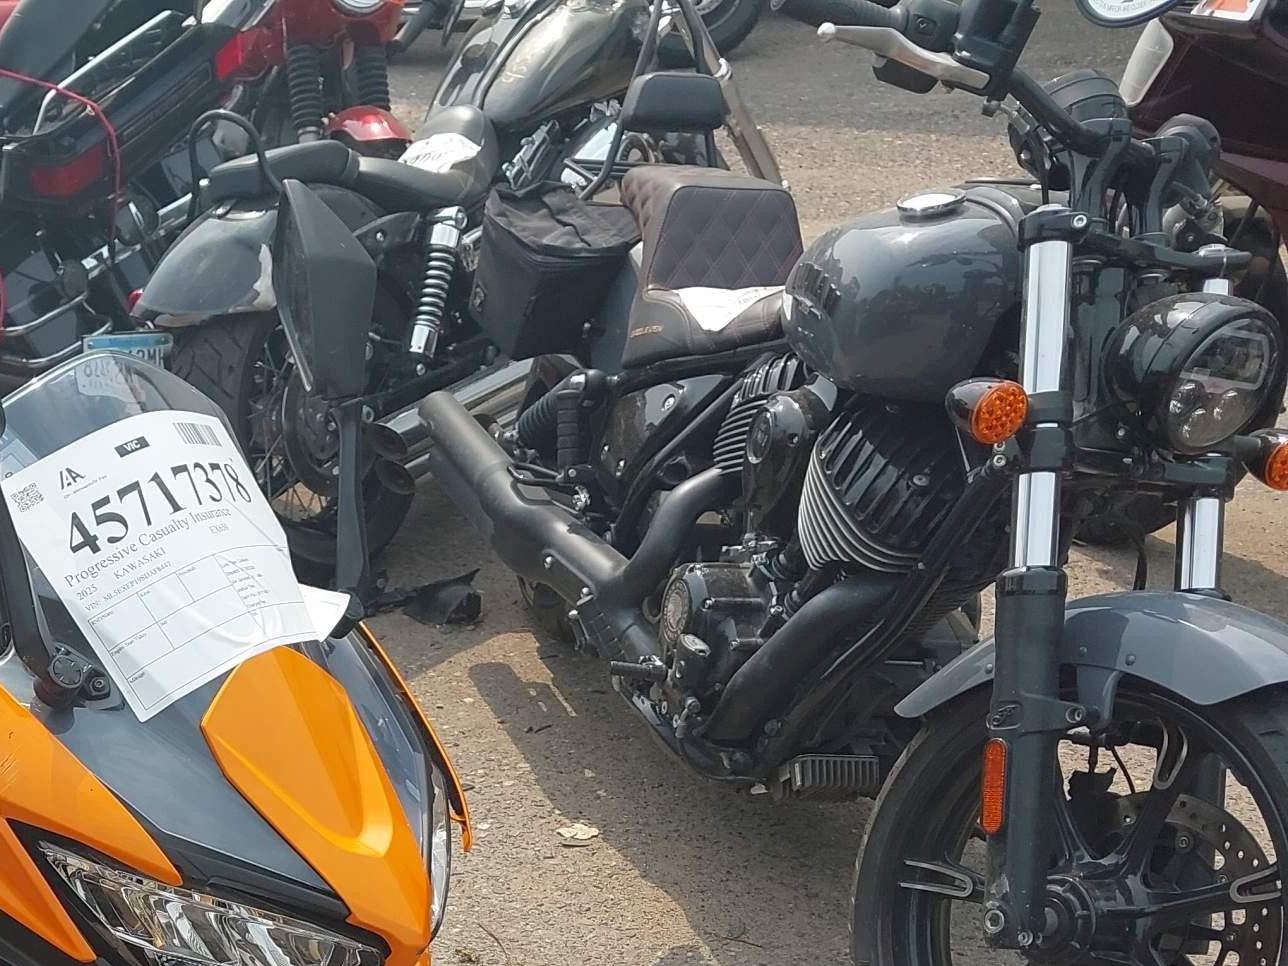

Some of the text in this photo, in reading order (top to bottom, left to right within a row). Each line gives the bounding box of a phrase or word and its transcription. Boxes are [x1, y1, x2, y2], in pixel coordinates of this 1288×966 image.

[123, 438, 141, 452] VIC
[69, 461, 252, 555] 45717378
[64, 507, 233, 588] Progressive Casualty Insurance
[75, 546, 167, 601] 2025 KAWASAKI
